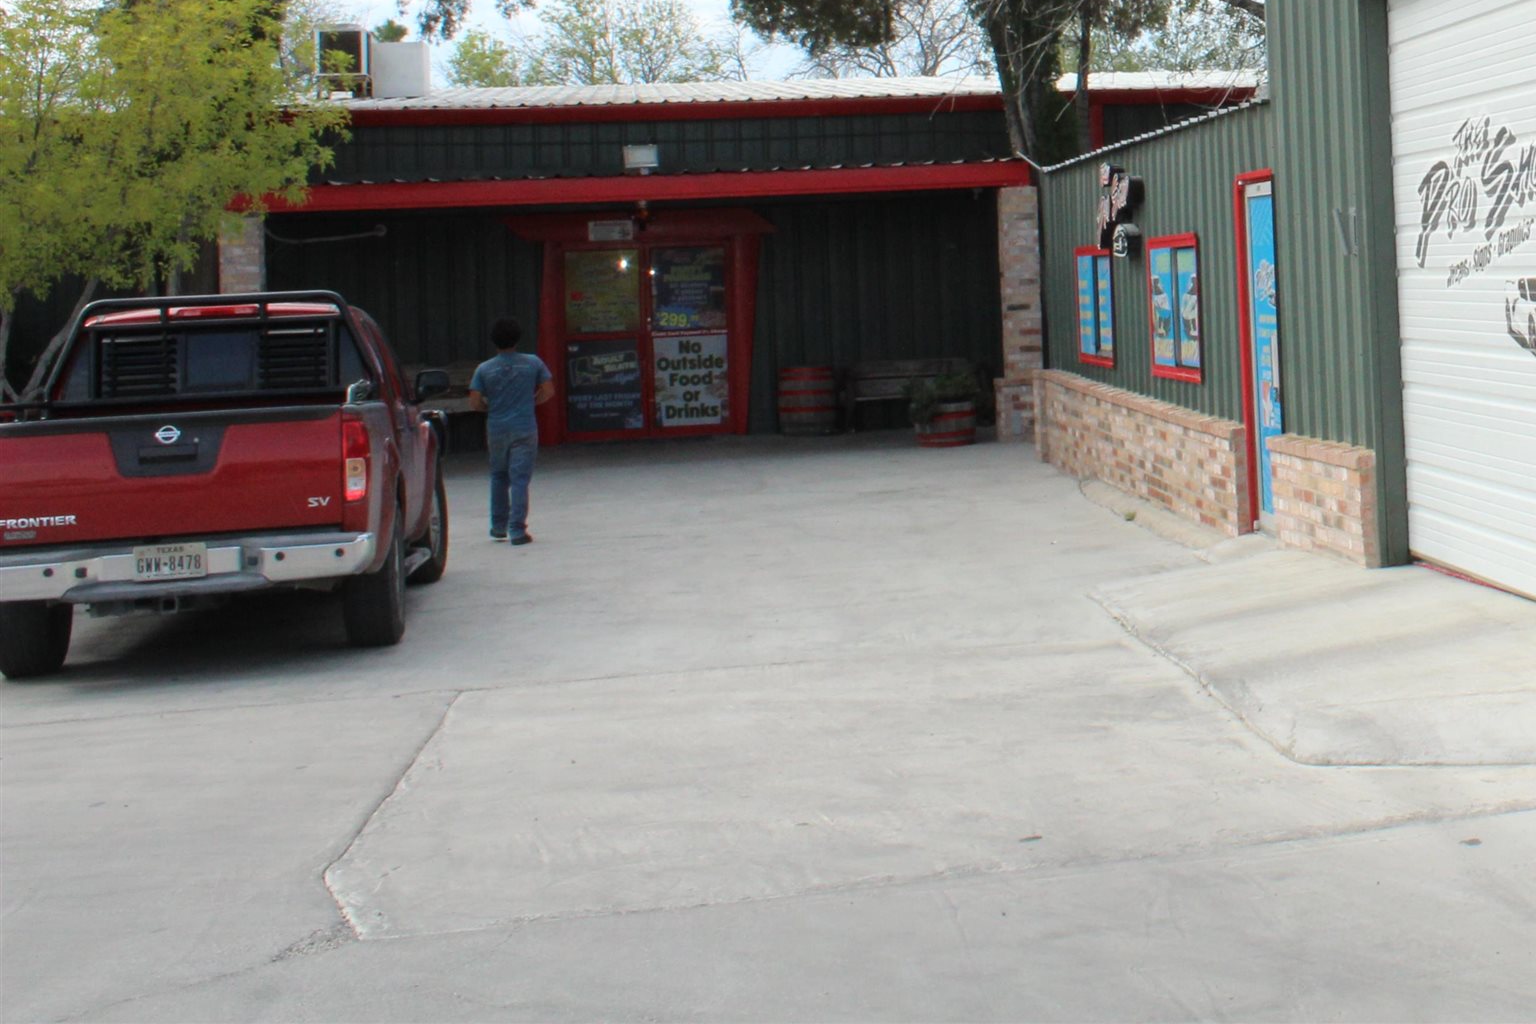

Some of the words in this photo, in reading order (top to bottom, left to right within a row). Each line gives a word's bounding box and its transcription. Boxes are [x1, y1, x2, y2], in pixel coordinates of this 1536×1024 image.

[679, 341, 701, 354] No
[657, 353, 724, 371] Outside
[669, 371, 713, 386] Food
[683, 390, 700, 402] or
[665, 403, 719, 419] Drinks
[307, 497, 331, 508] SV
[156, 546, 184, 554] TEXAS
